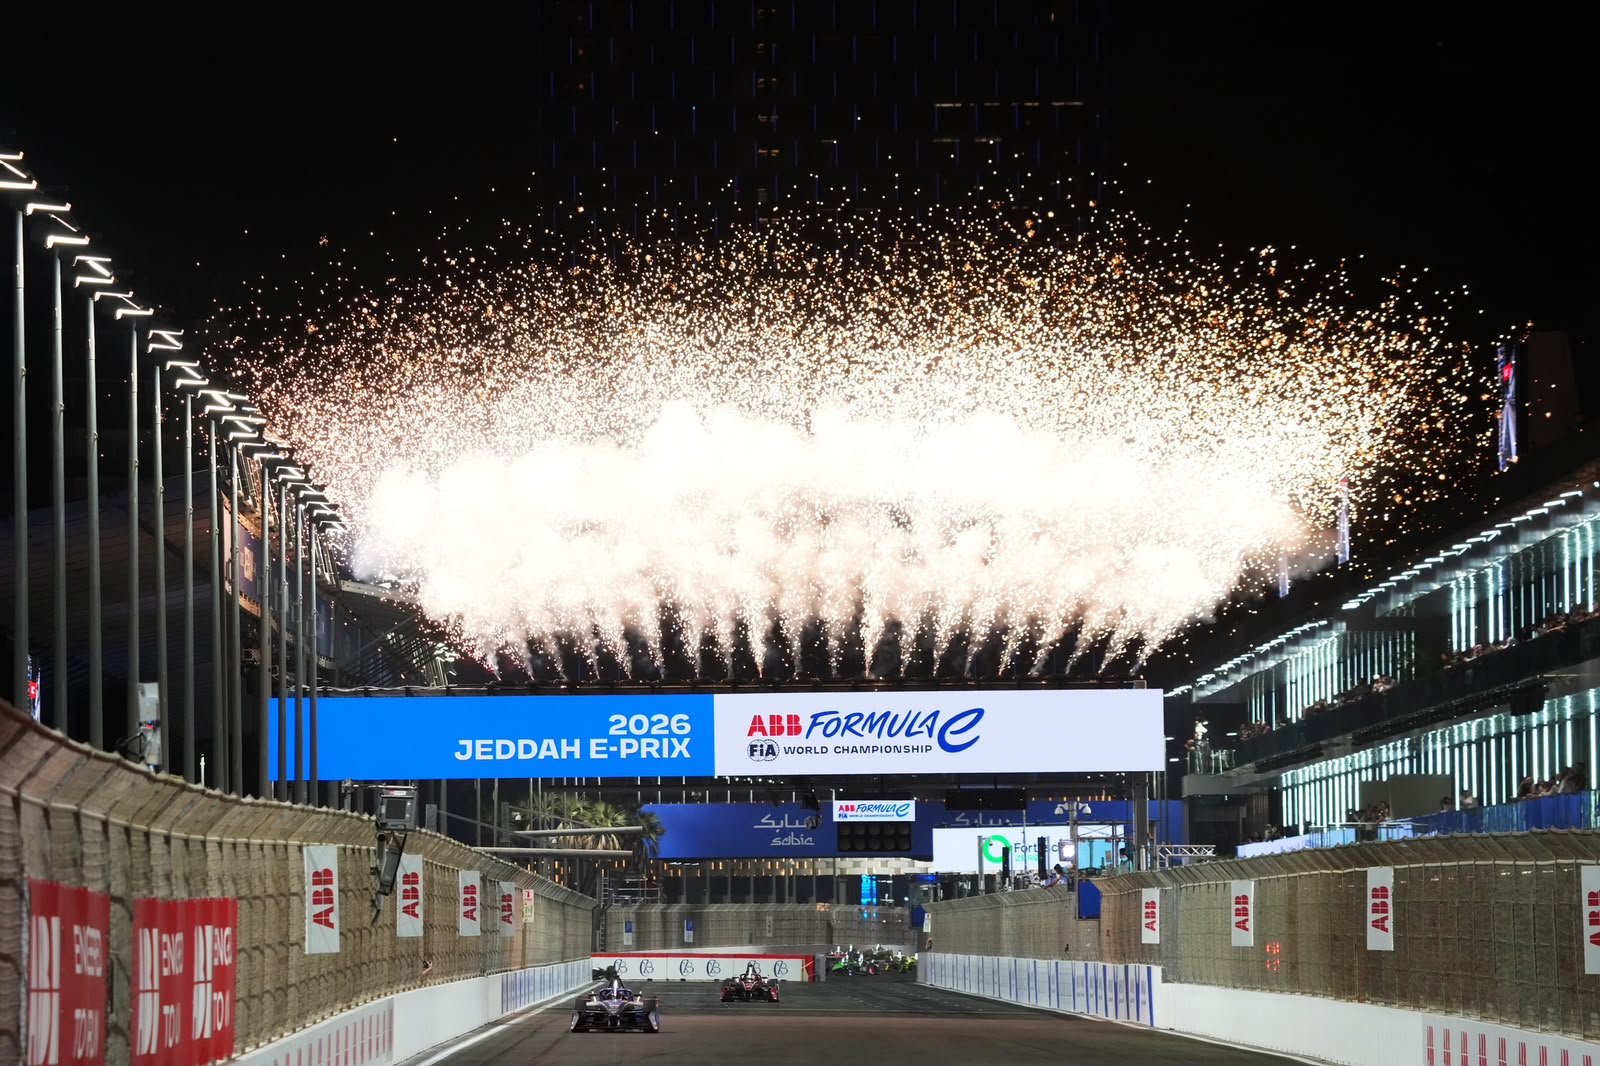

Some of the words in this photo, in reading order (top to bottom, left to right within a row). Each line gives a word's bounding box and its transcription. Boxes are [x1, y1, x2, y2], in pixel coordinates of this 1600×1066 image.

[608, 713, 692, 735] 2026
[747, 714, 803, 737] ABB
[805, 710, 941, 740] FORMULA
[454, 738, 581, 761] JEDDAH
[589, 737, 692, 759] E-PRIX
[783, 745, 829, 755] WORLD
[833, 744, 933, 754] CHAMPIONSHIP
[838, 804, 855, 812] ABB
[855, 803, 897, 813] FORMULA
[769, 831, 815, 846] sabic
[311, 867, 335, 929] ABB
[402, 871, 420, 919] ABB
[463, 884, 477, 922] ABB
[501, 893, 513, 925] ABB
[1371, 885, 1390, 934] ABB
[1145, 900, 1157, 932] ABB
[1234, 894, 1250, 933] ABB
